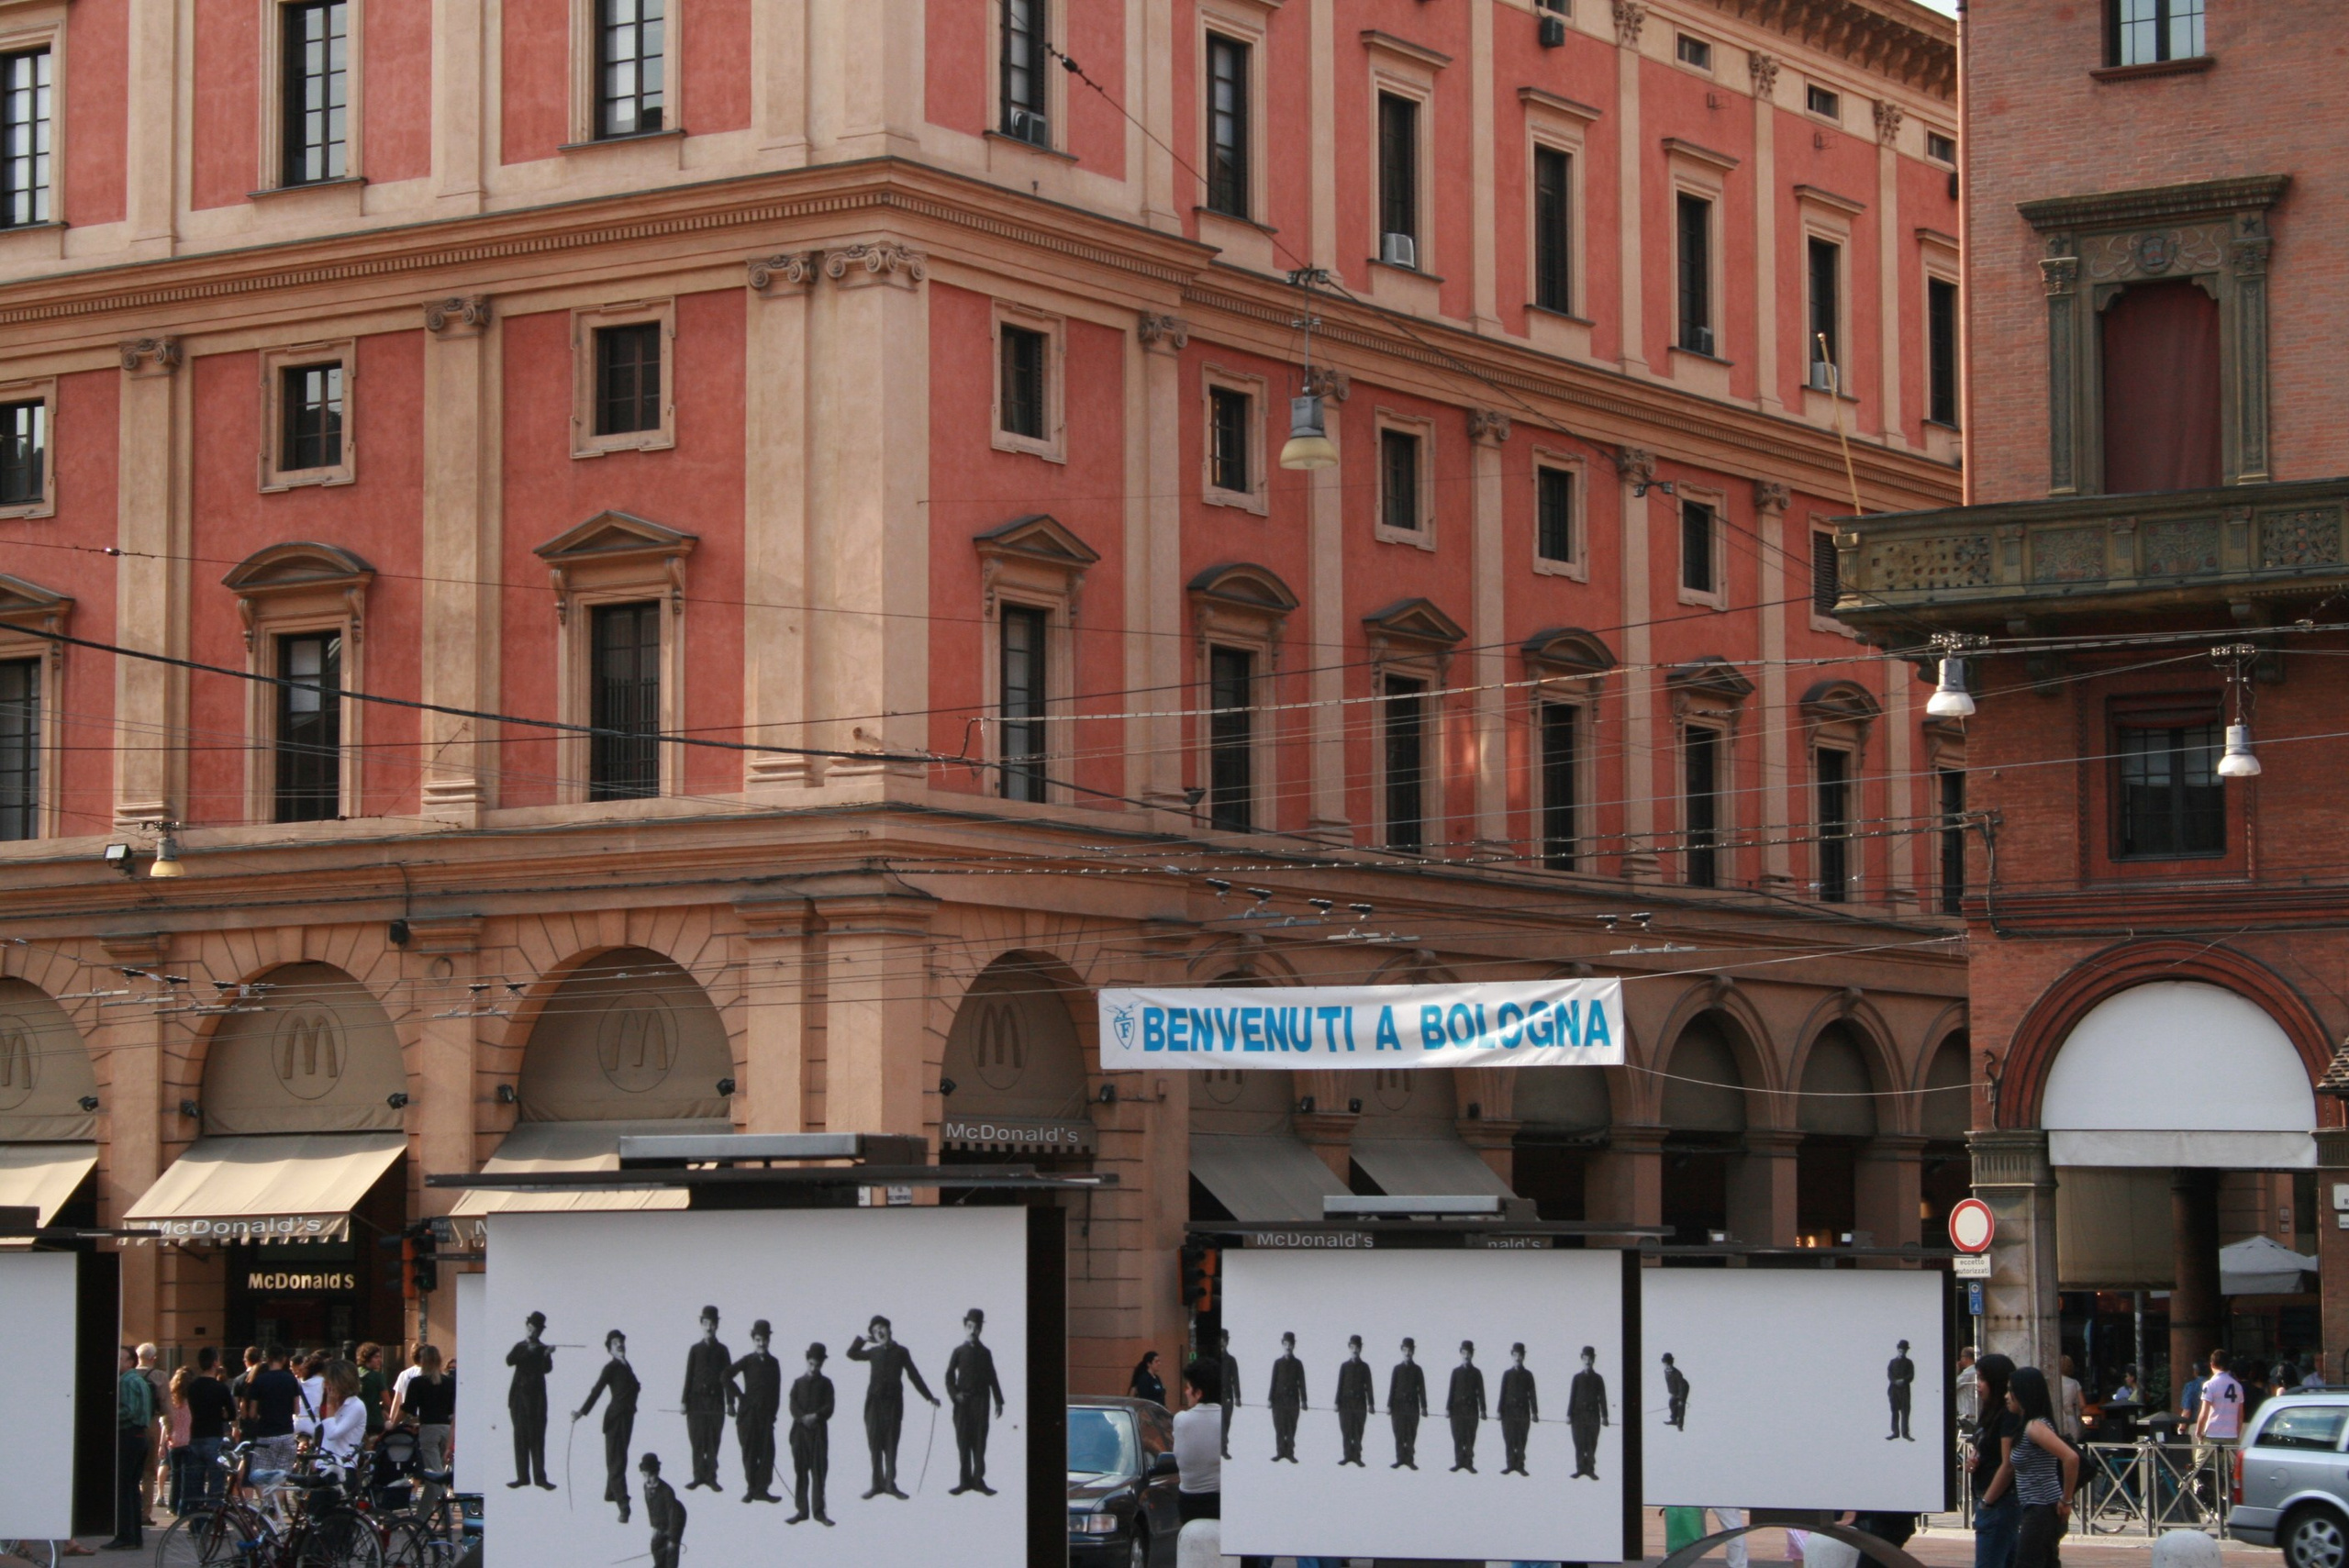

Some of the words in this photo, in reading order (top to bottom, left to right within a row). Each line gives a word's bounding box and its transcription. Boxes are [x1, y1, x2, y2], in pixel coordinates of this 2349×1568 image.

[1143, 1006, 1355, 1053] BENVENUTI
[1376, 1007, 1402, 1051] A
[1420, 999, 1612, 1051] BOLOGNA
[946, 1122, 1079, 1143] McDonald's
[148, 1217, 322, 1236] McDonald's
[1256, 1232, 1375, 1248] McDonald's
[248, 1273, 355, 1290] McDonalds
[2224, 1384, 2238, 1403] 4
